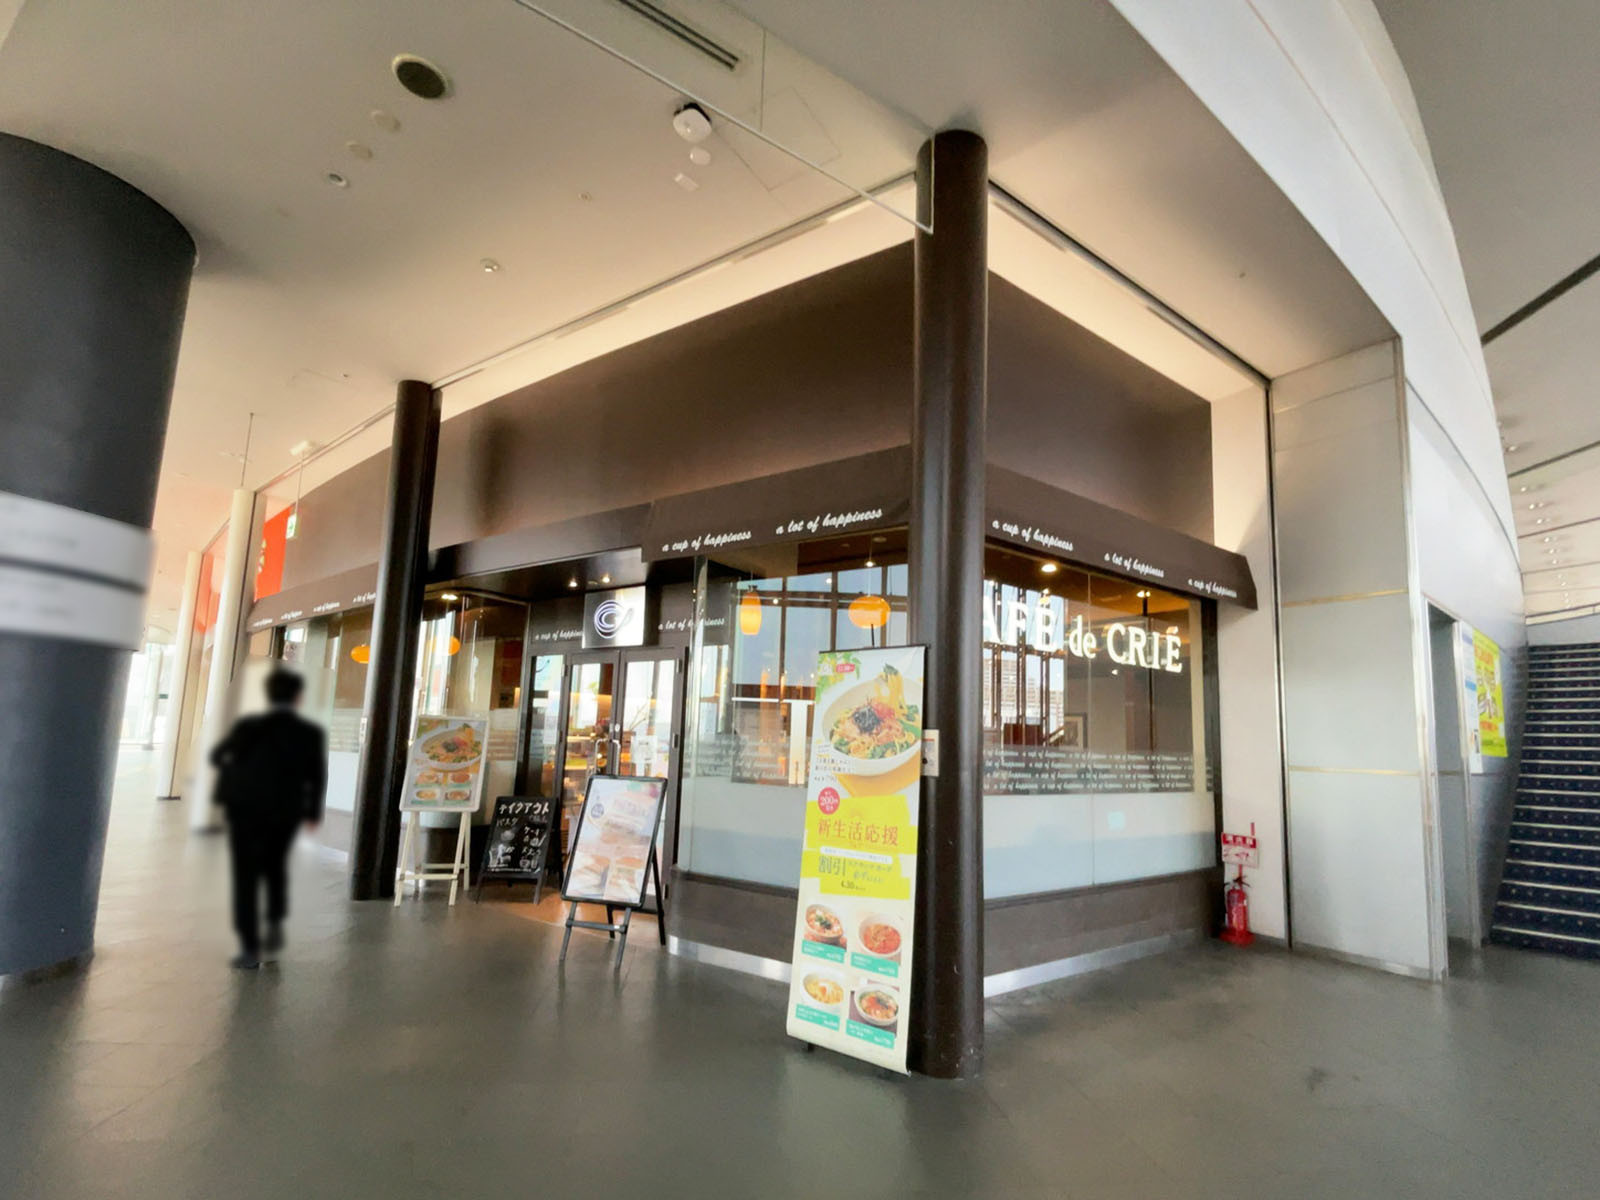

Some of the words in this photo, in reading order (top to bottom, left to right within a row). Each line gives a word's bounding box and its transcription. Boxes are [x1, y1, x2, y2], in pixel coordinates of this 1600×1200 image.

[776, 526, 784, 534] a
[788, 520, 804, 533] lot
[806, 516, 820, 533] of
[822, 508, 882, 528] happiness
[662, 544, 669, 552] a
[672, 540, 689, 552] cup
[691, 536, 702, 551] of
[703, 533, 752, 548] happiness
[992, 520, 999, 529] a
[1002, 522, 1019, 537] cup
[1021, 526, 1032, 542] of
[1033, 528, 1073, 552] happiness
[1112, 552, 1123, 566] lot
[1124, 557, 1132, 571] of
[1133, 558, 1164, 578] happiness
[1068, 615, 1097, 659] de
[1106, 622, 1183, 673] CRIÉ
[816, 818, 899, 846] 新生活応援
